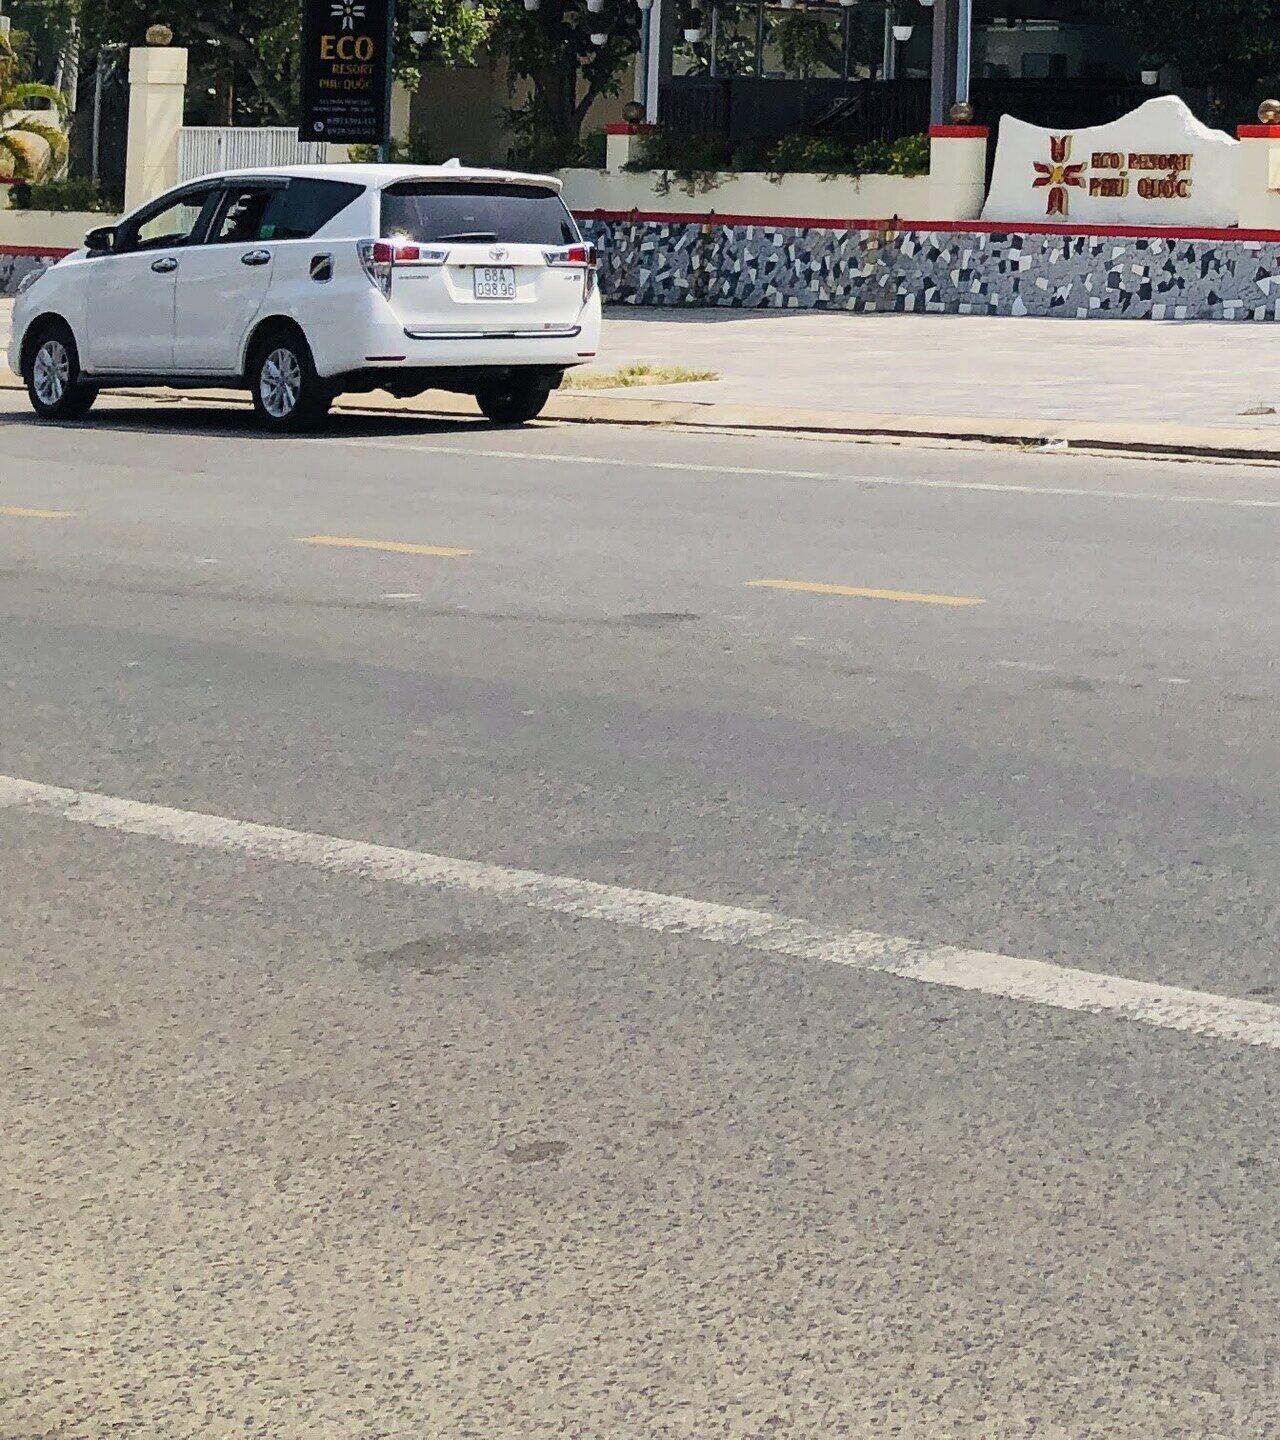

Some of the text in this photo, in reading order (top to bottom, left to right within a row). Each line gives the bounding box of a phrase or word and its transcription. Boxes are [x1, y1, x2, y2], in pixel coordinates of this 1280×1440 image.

[320, 35, 374, 60] ECO
[1091, 151, 1194, 171] ECO RESORT
[1136, 166, 1194, 200] QUỐC
[484, 269, 505, 282] 68A
